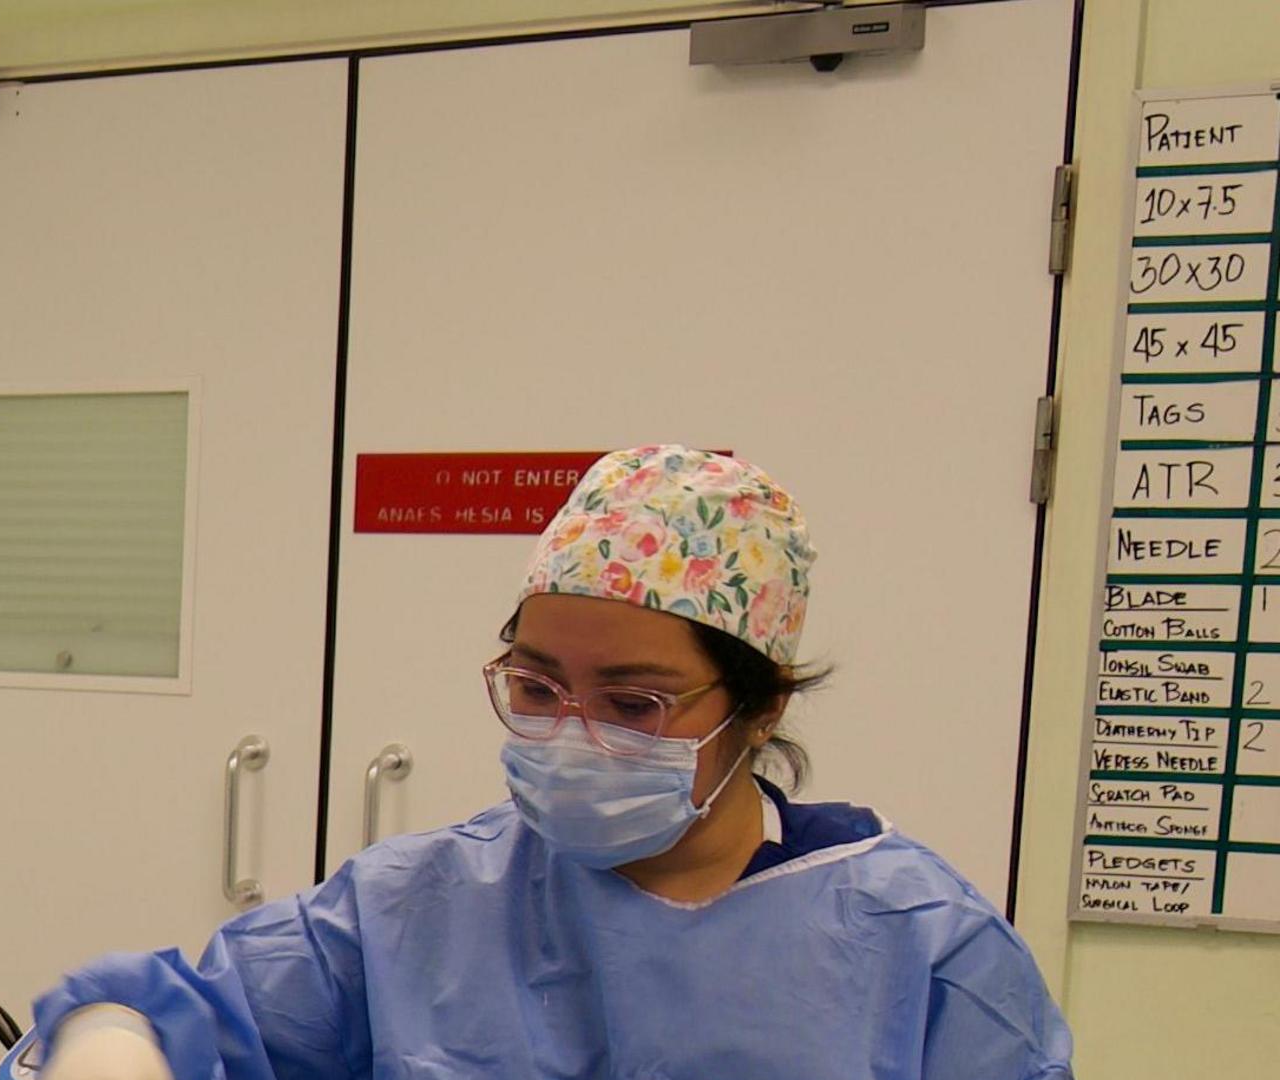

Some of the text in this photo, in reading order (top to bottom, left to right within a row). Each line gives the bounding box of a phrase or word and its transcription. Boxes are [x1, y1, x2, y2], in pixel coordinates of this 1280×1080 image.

[1144, 114, 1243, 152] PATIENT
[1130, 253, 1245, 293] 30x30
[1133, 327, 1167, 362] 45
[1200, 323, 1244, 357] 45
[1133, 395, 1205, 426] TAGS
[462, 470, 502, 486] NOT
[514, 470, 579, 486] ENTER
[1132, 461, 1219, 499] ATR
[526, 507, 544, 524] IS
[1118, 528, 1222, 561] NEEDLE
[1104, 585, 1187, 609] BLADE
[1103, 617, 1220, 639] COTTON BALLS
[1100, 650, 1210, 676] TONSIL SWAB
[1099, 681, 1210, 704] ELASTIC BAND
[1246, 680, 1271, 705] 2
[1179, 720, 1216, 741] TIP
[1243, 721, 1267, 752] 2
[1094, 749, 1218, 770] VERESS NEEDLE
[1090, 783, 1195, 804] SCRATCH PAD
[1087, 850, 1196, 873] PLEDGETS
[1152, 897, 1190, 914] LOOP
